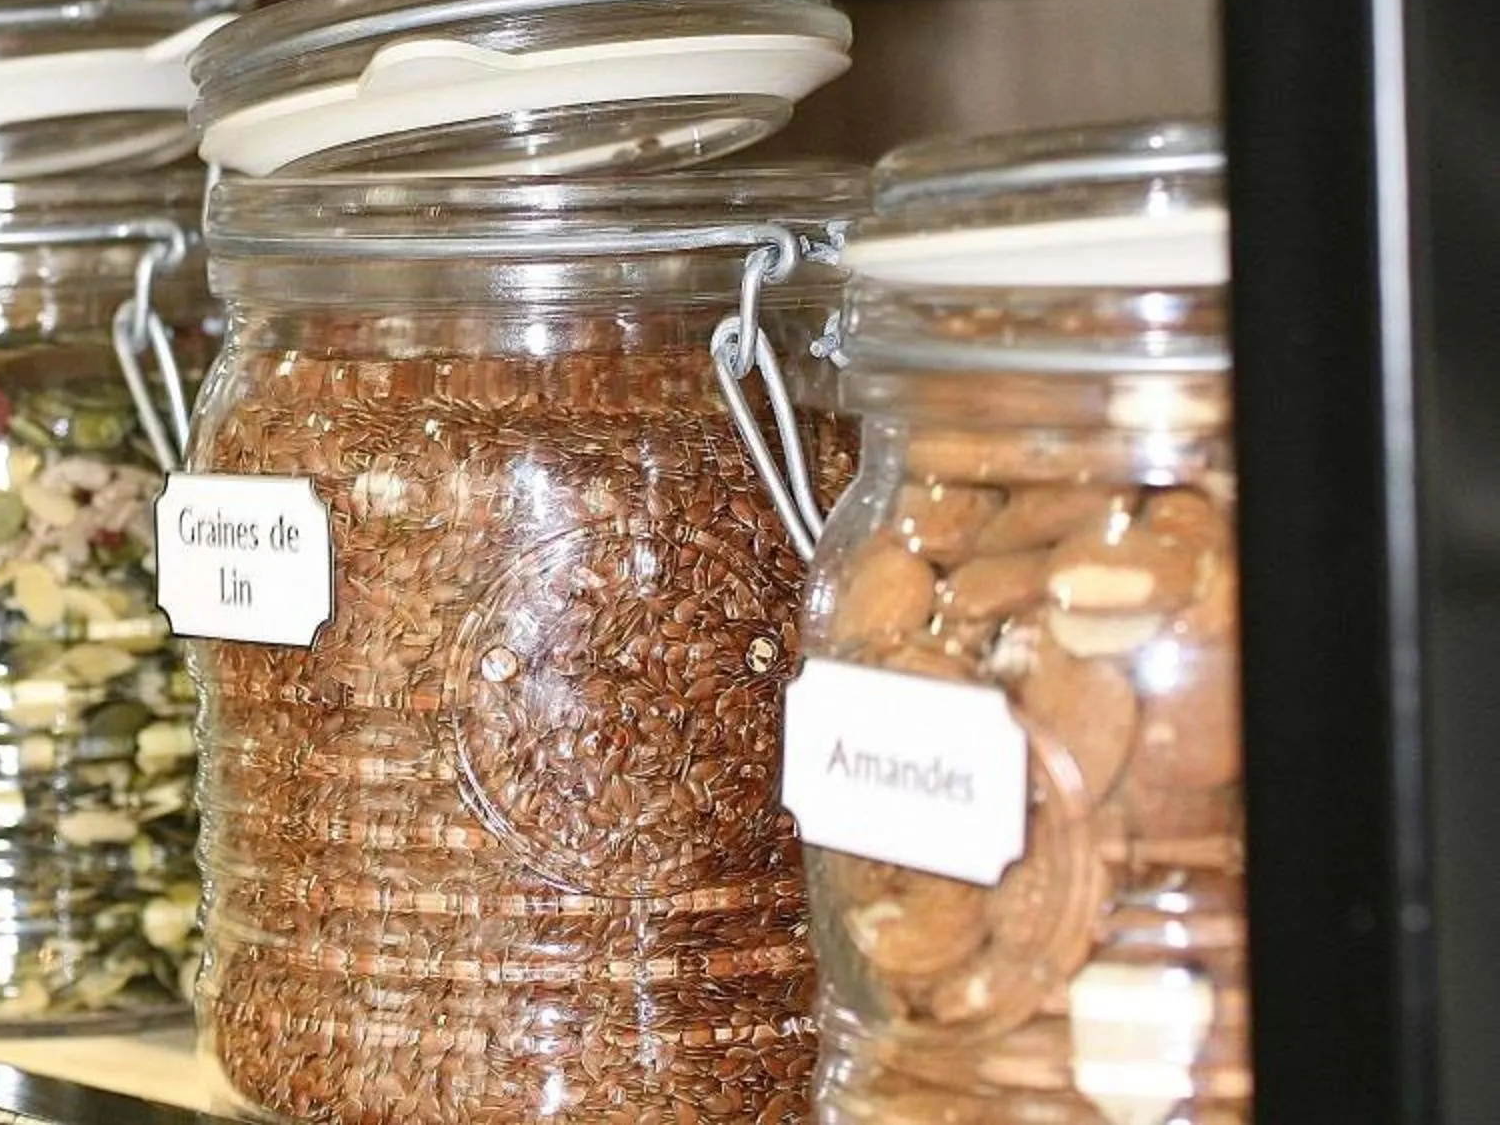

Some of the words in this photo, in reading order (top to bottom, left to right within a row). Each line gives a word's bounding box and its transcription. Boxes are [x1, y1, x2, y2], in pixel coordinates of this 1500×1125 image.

[179, 507, 260, 551] Graines
[270, 514, 300, 553] de
[219, 566, 253, 606] Lin
[825, 736, 975, 806] Amandes
